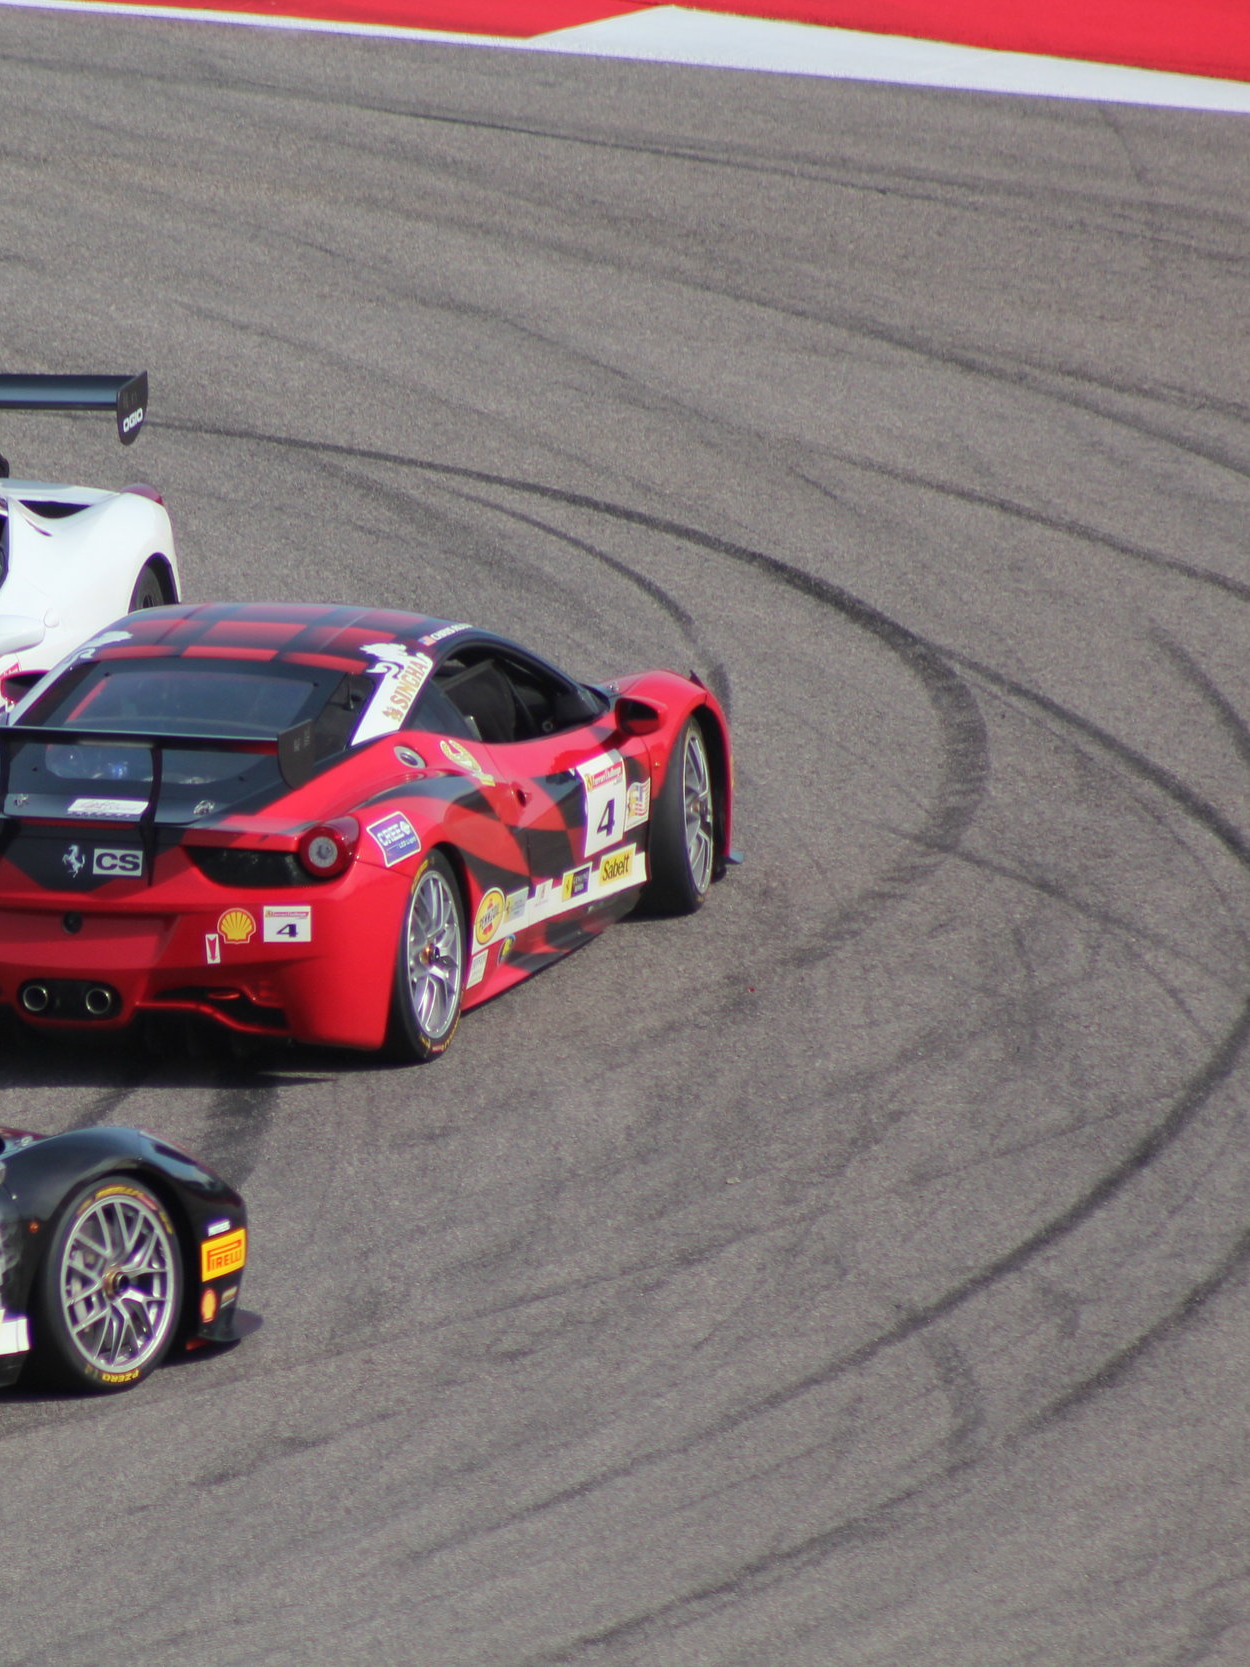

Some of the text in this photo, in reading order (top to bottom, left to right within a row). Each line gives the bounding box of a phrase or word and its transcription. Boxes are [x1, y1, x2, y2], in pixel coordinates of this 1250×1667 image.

[390, 661, 429, 710] SINGHA
[596, 798, 615, 836] 4
[377, 823, 405, 846] CREE
[95, 852, 140, 872] CS
[602, 852, 630, 881] Sabelt
[276, 923, 298, 937] 4
[207, 1239, 243, 1273] PIRELLI
